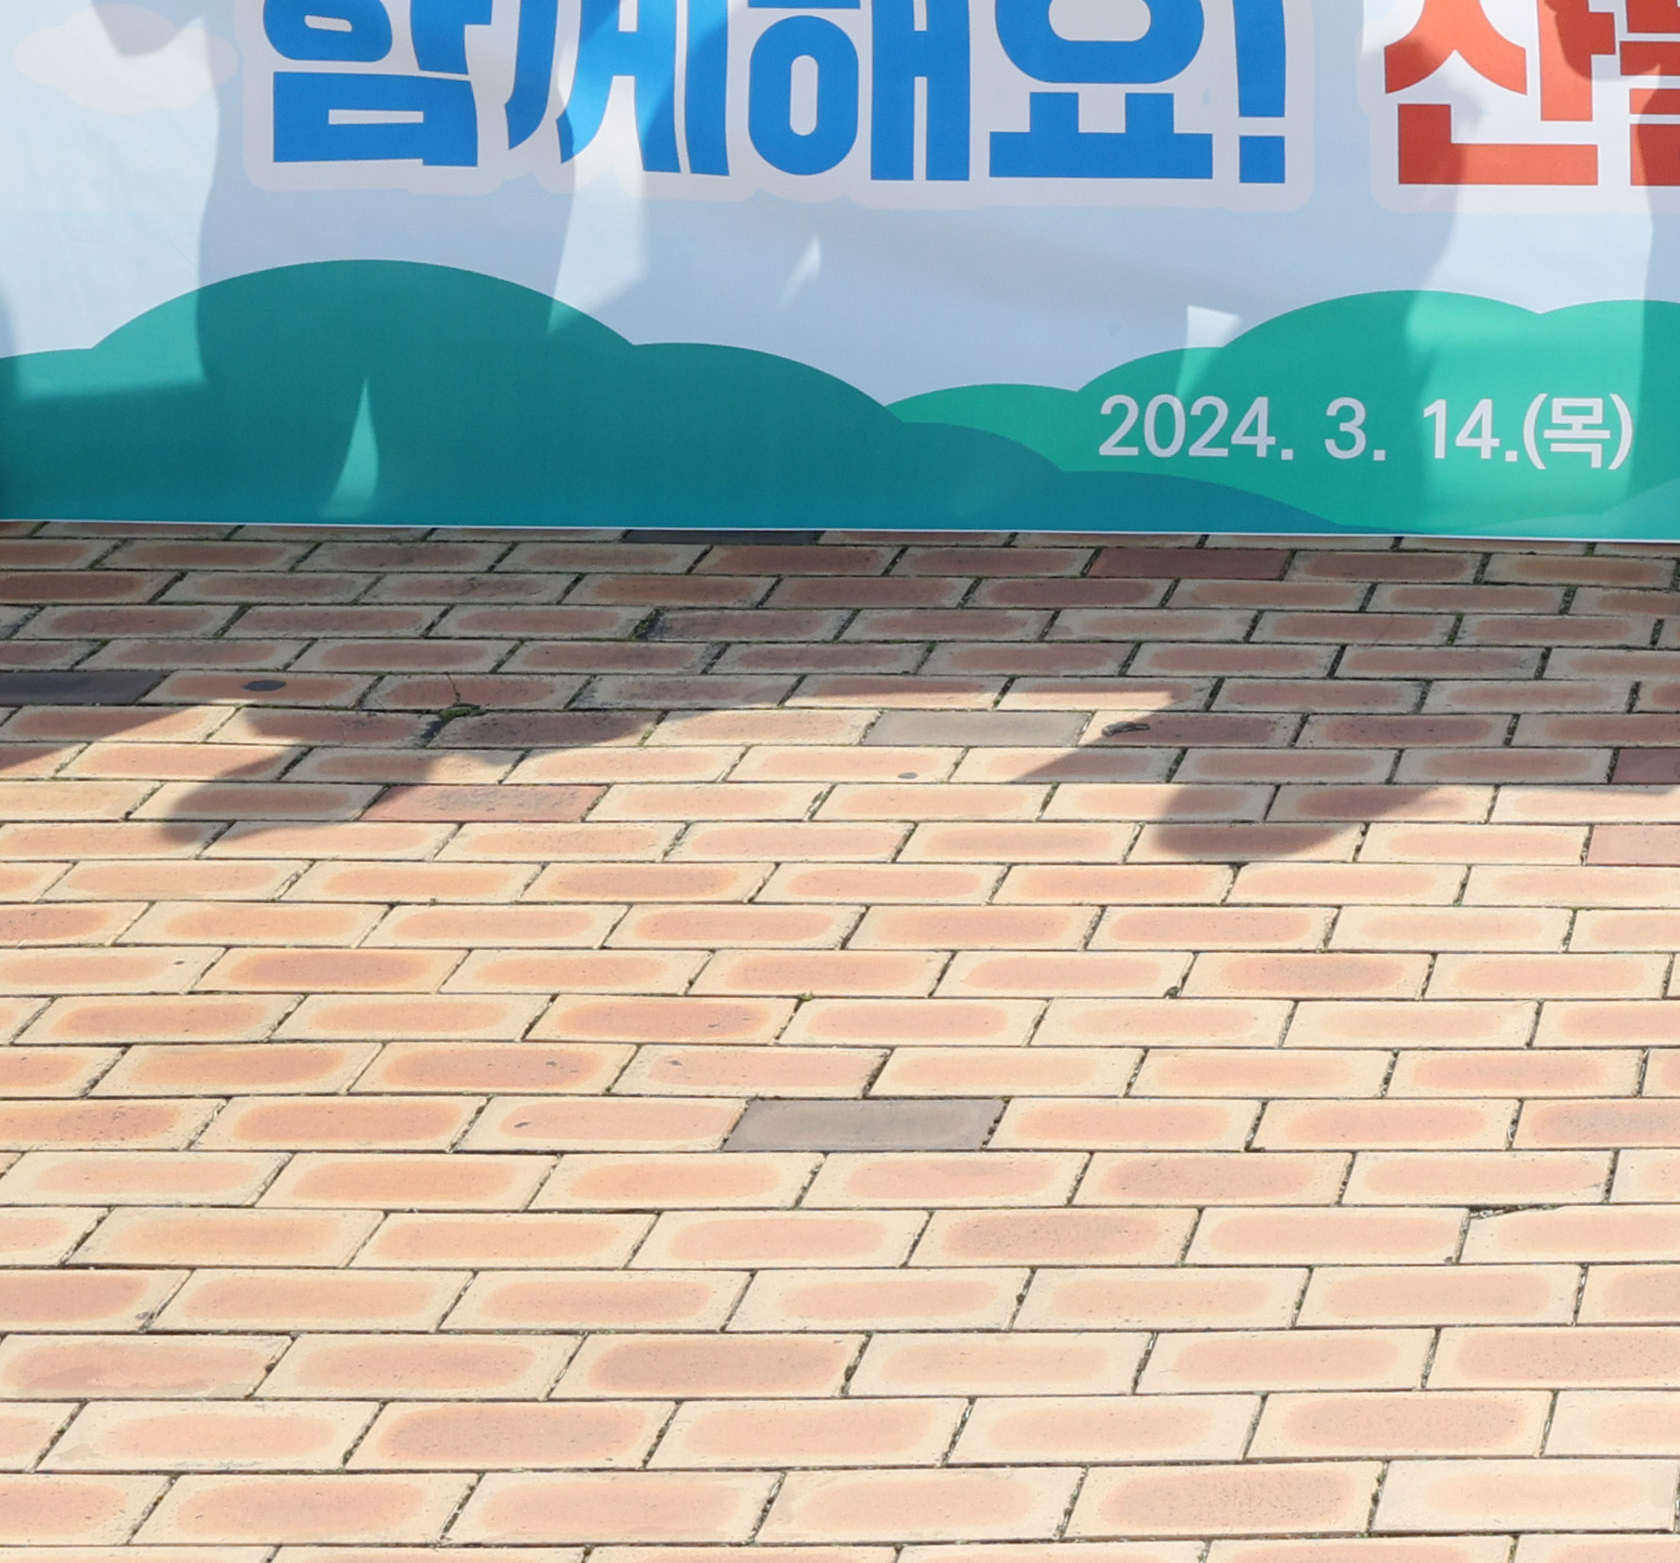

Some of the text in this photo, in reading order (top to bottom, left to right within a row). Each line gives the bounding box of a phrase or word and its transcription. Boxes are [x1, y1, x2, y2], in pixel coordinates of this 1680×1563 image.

[1097, 391, 1636, 471] 2024. 3. 14.(목)
